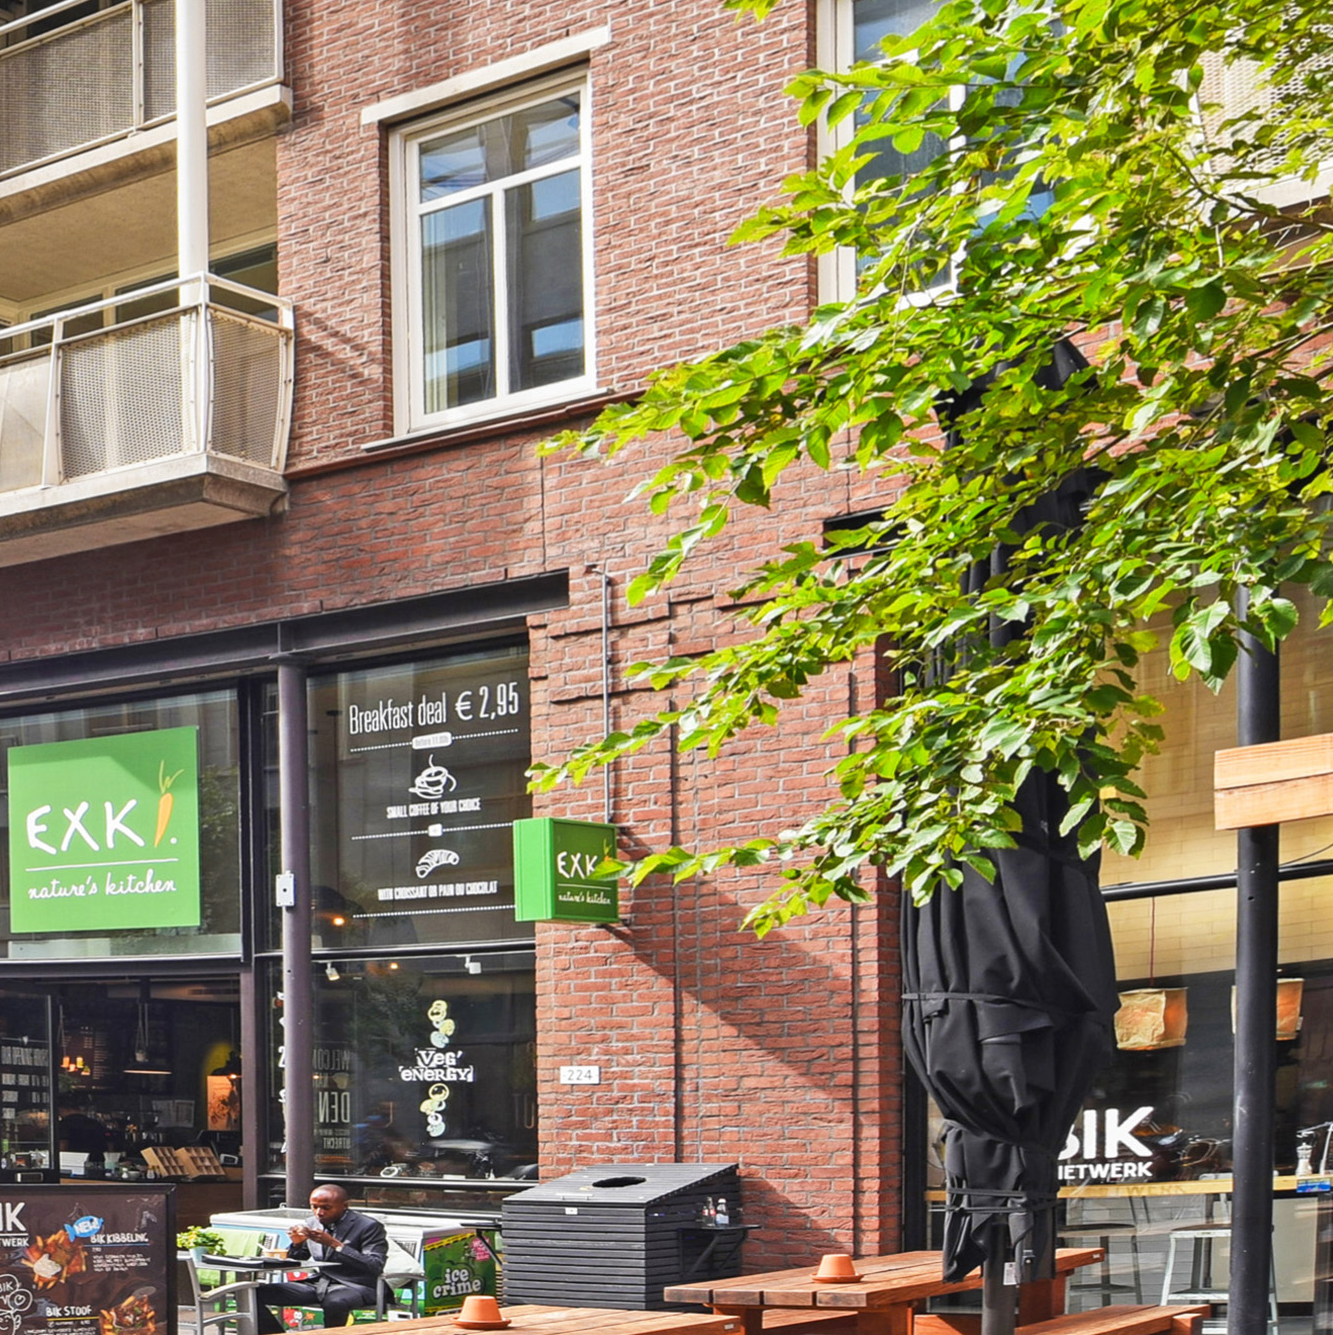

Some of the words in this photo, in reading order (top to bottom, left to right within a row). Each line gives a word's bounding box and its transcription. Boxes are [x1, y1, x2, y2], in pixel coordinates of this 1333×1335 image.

[349, 698, 414, 735] Breakfast
[418, 692, 447, 727] deal
[455, 691, 474, 720] €
[479, 682, 520, 720] 2,95
[386, 805, 408, 819] SMALL
[409, 802, 430, 817] COFFEE
[430, 802, 439, 815] OF
[440, 800, 457, 814] YOUR
[458, 797, 481, 812] CHOICE
[27, 875, 98, 900] nature's
[105, 868, 177, 895] kitchen
[394, 885, 428, 900] CROISSANT
[465, 880, 498, 895] CHOCOLAT
[558, 891, 585, 903] nature's
[586, 891, 611, 905] kitchen
[567, 1069, 594, 1081] 224
[1058, 1161, 1153, 1180] IETWERK
[73, 1216, 100, 1235] NEW!
[90, 1233, 106, 1244] BIK
[444, 1267, 469, 1284] ice
[433, 1279, 481, 1298] crime
[45, 1306, 62, 1317] BIK
[63, 1305, 92, 1317] STOOF
